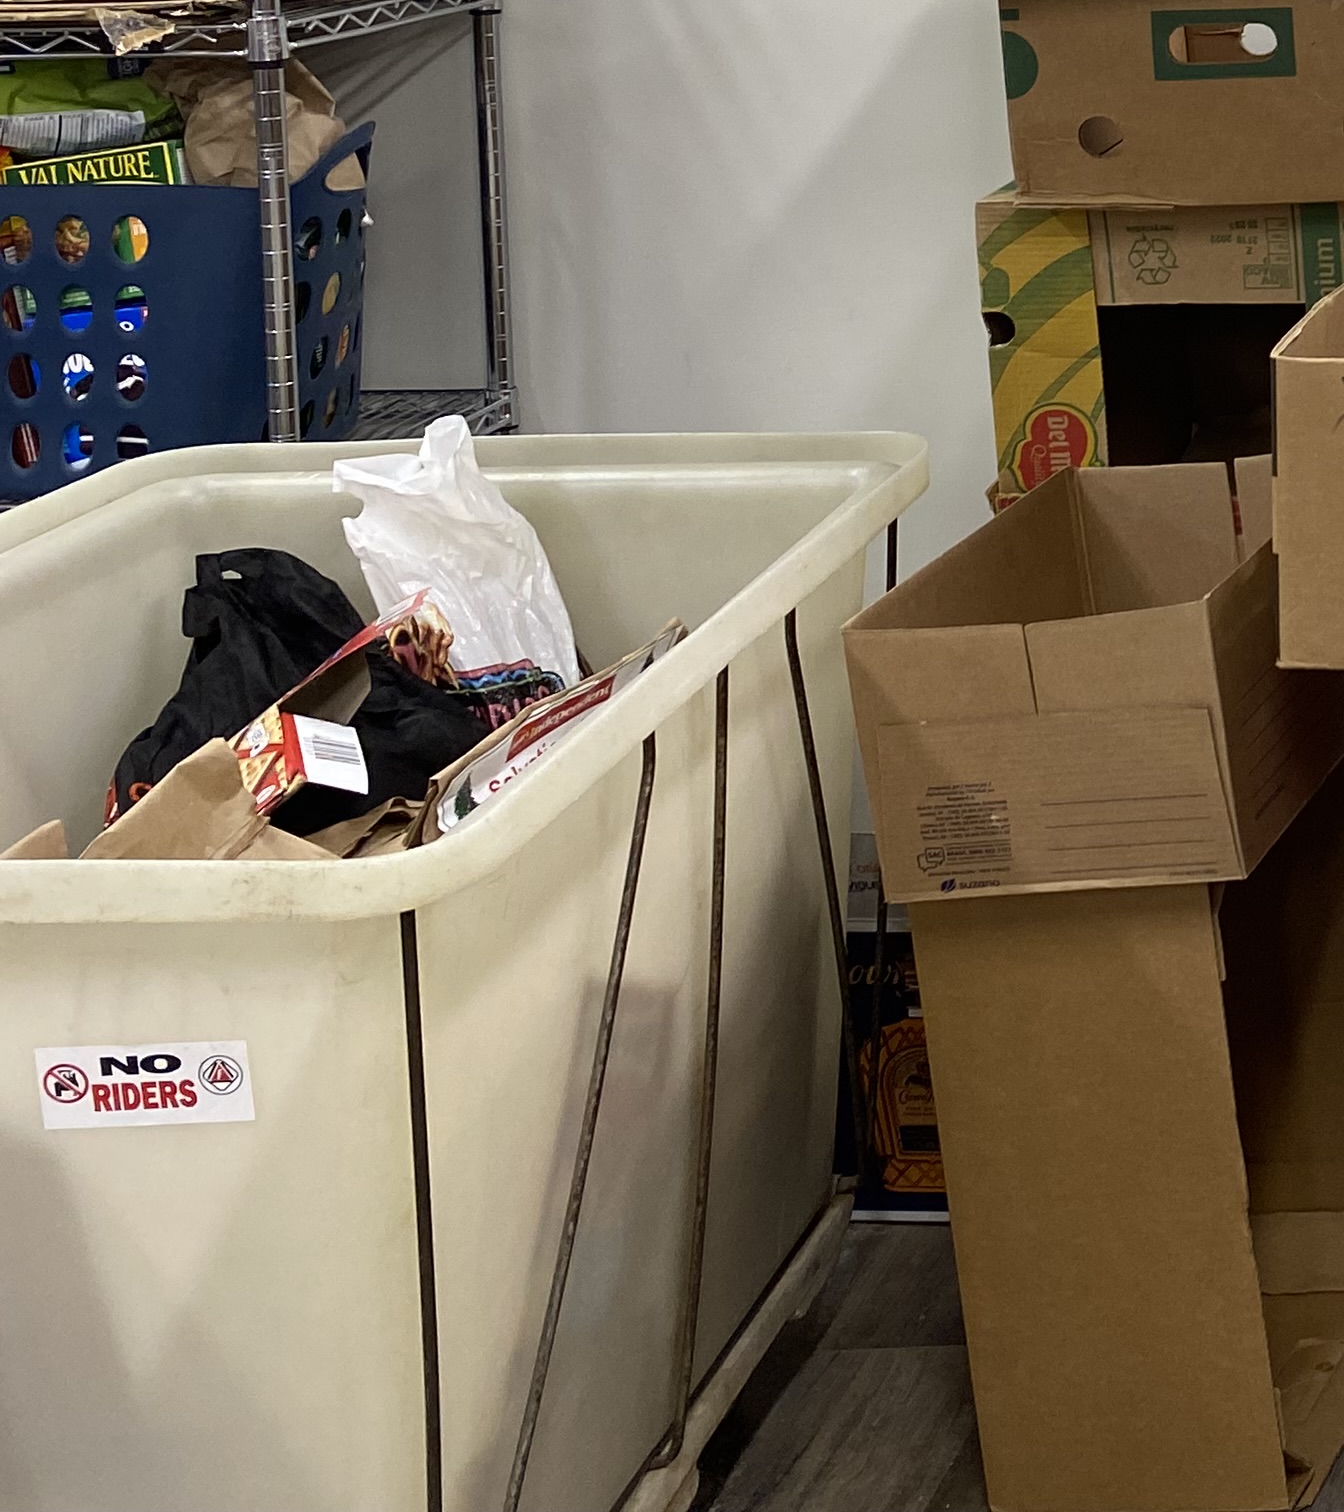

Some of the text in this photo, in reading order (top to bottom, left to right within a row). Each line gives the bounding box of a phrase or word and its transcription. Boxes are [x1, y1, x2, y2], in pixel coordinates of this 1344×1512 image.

[66, 151, 154, 184] NATURE
[1046, 415, 1071, 448] Del
[100, 1054, 182, 1076] NO
[92, 1079, 198, 1112] RIDERS
